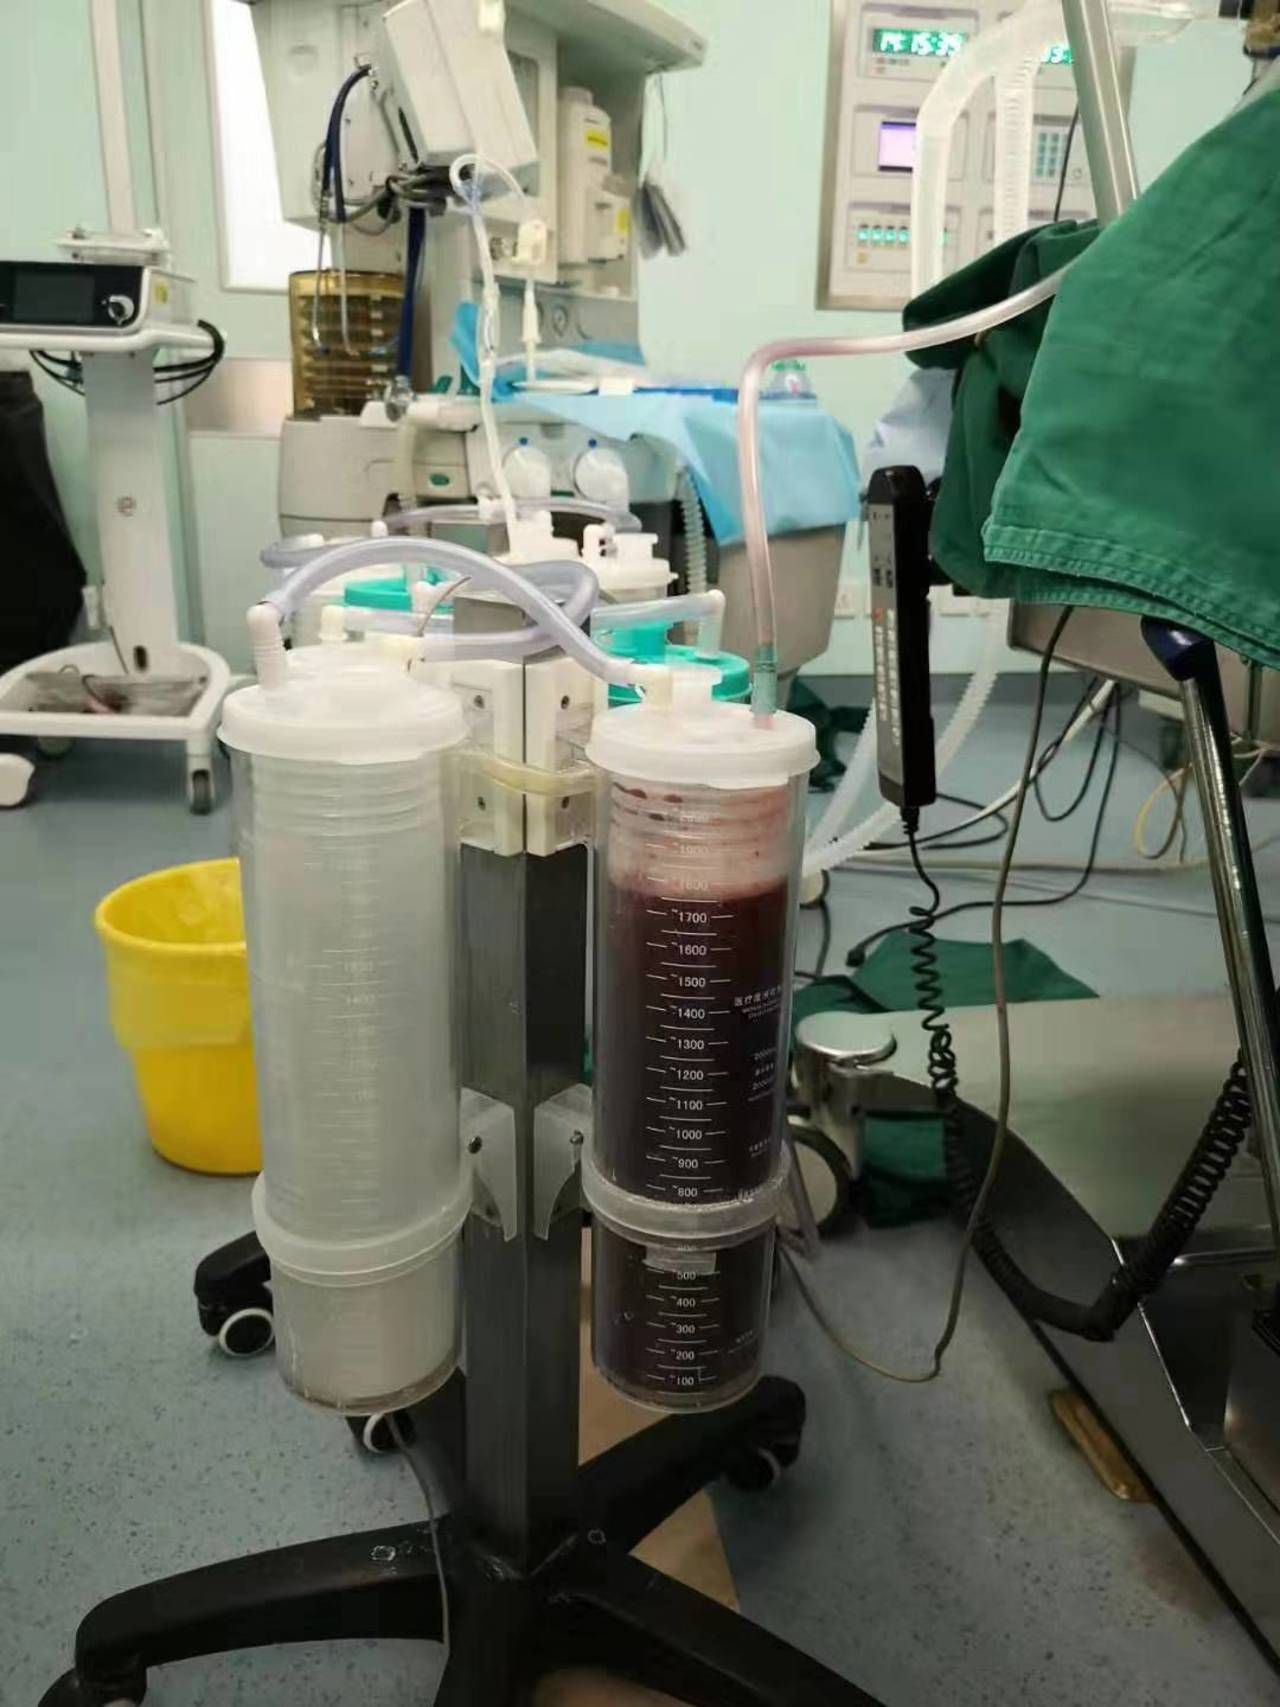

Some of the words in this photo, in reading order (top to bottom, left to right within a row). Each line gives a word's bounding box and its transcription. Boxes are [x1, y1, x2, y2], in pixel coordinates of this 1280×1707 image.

[679, 912, 708, 923] 1700
[679, 944, 708, 956] 1600
[678, 976, 706, 988] 1500
[678, 1008, 706, 1019] 1400
[678, 1039, 705, 1050] 1300
[677, 1069, 704, 1080] 1200
[677, 1100, 703, 1110] 1100
[676, 1129, 702, 1140] 1000
[678, 1158, 699, 1169] 900
[677, 1187, 698, 1197] 800
[677, 1271, 697, 1281] 500
[677, 1297, 696, 1308] 400
[675, 1324, 696, 1334] 300
[675, 1350, 695, 1361] 200
[676, 1376, 695, 1386] 100
